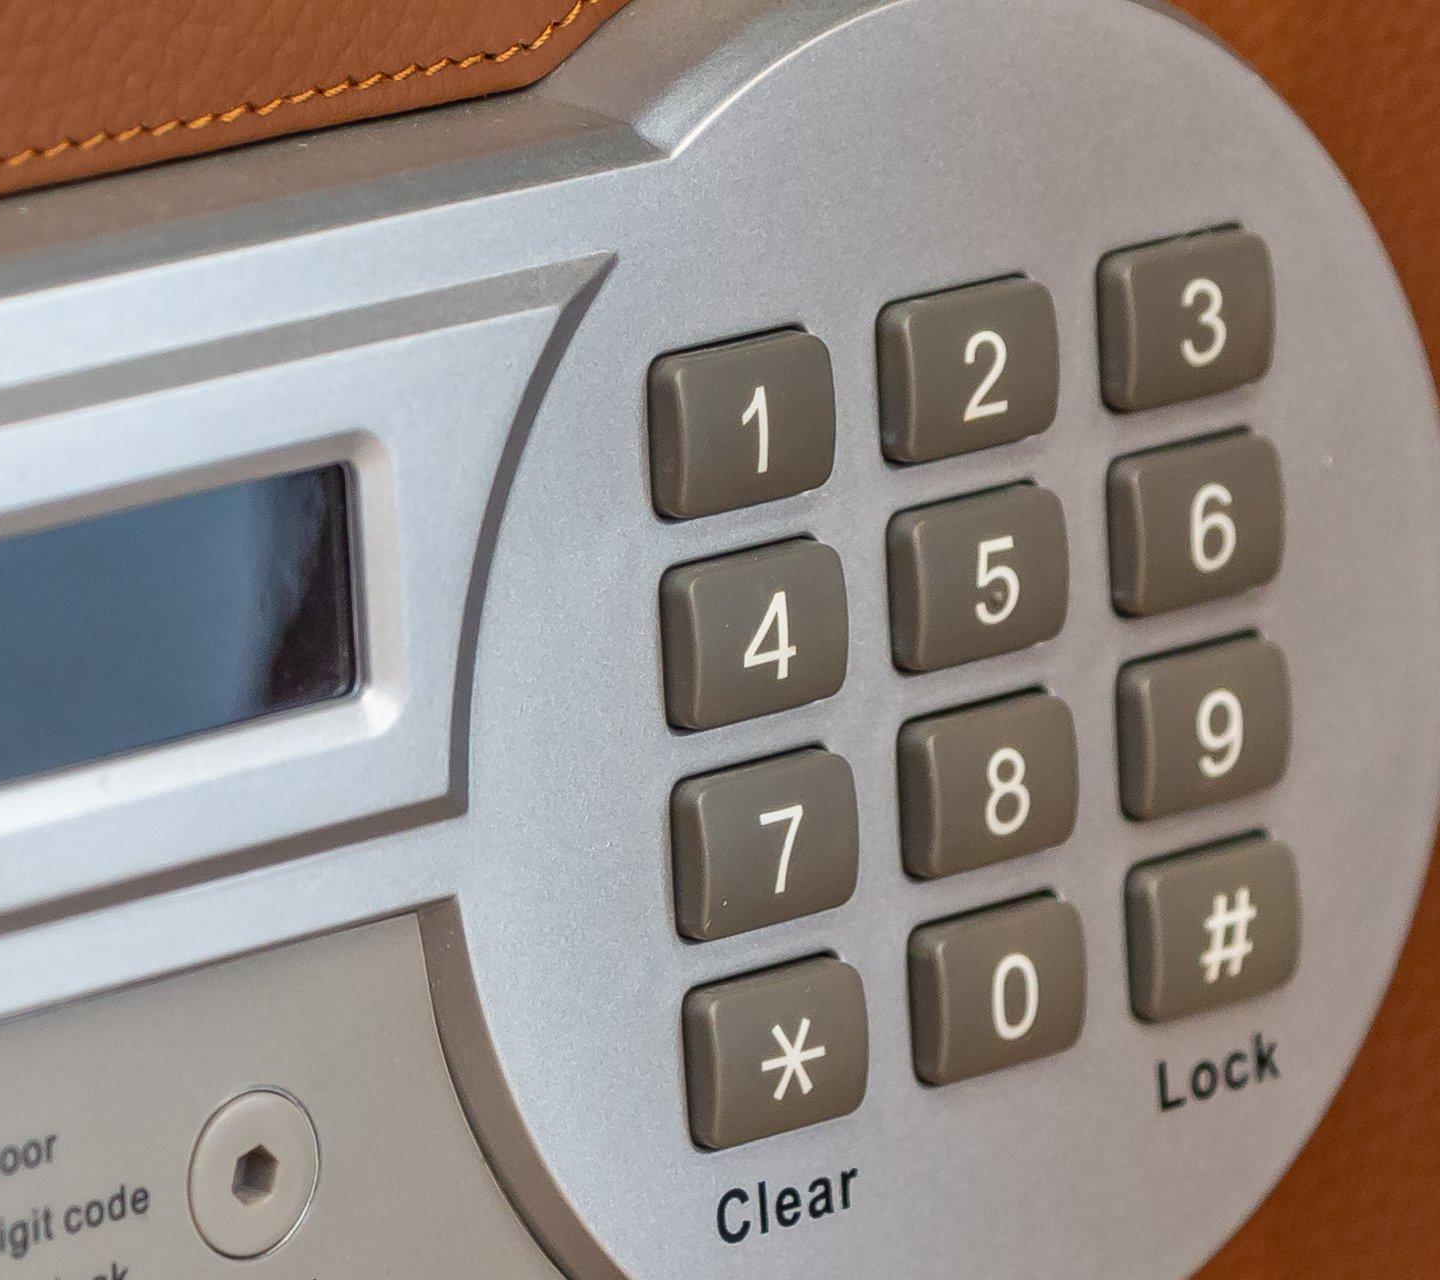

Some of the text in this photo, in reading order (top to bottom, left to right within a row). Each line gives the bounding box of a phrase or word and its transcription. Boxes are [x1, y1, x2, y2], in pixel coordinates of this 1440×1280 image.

[741, 278, 1227, 474] 1 2 3
[743, 483, 1237, 680] 4 5 6
[758, 689, 1244, 895] 7 8 9
[991, 951, 1039, 1040] 0
[1200, 886, 1258, 983] #
[1157, 1033, 1282, 1112] Lock
[64, 1184, 151, 1235] code
[716, 1162, 861, 1244] Clear
